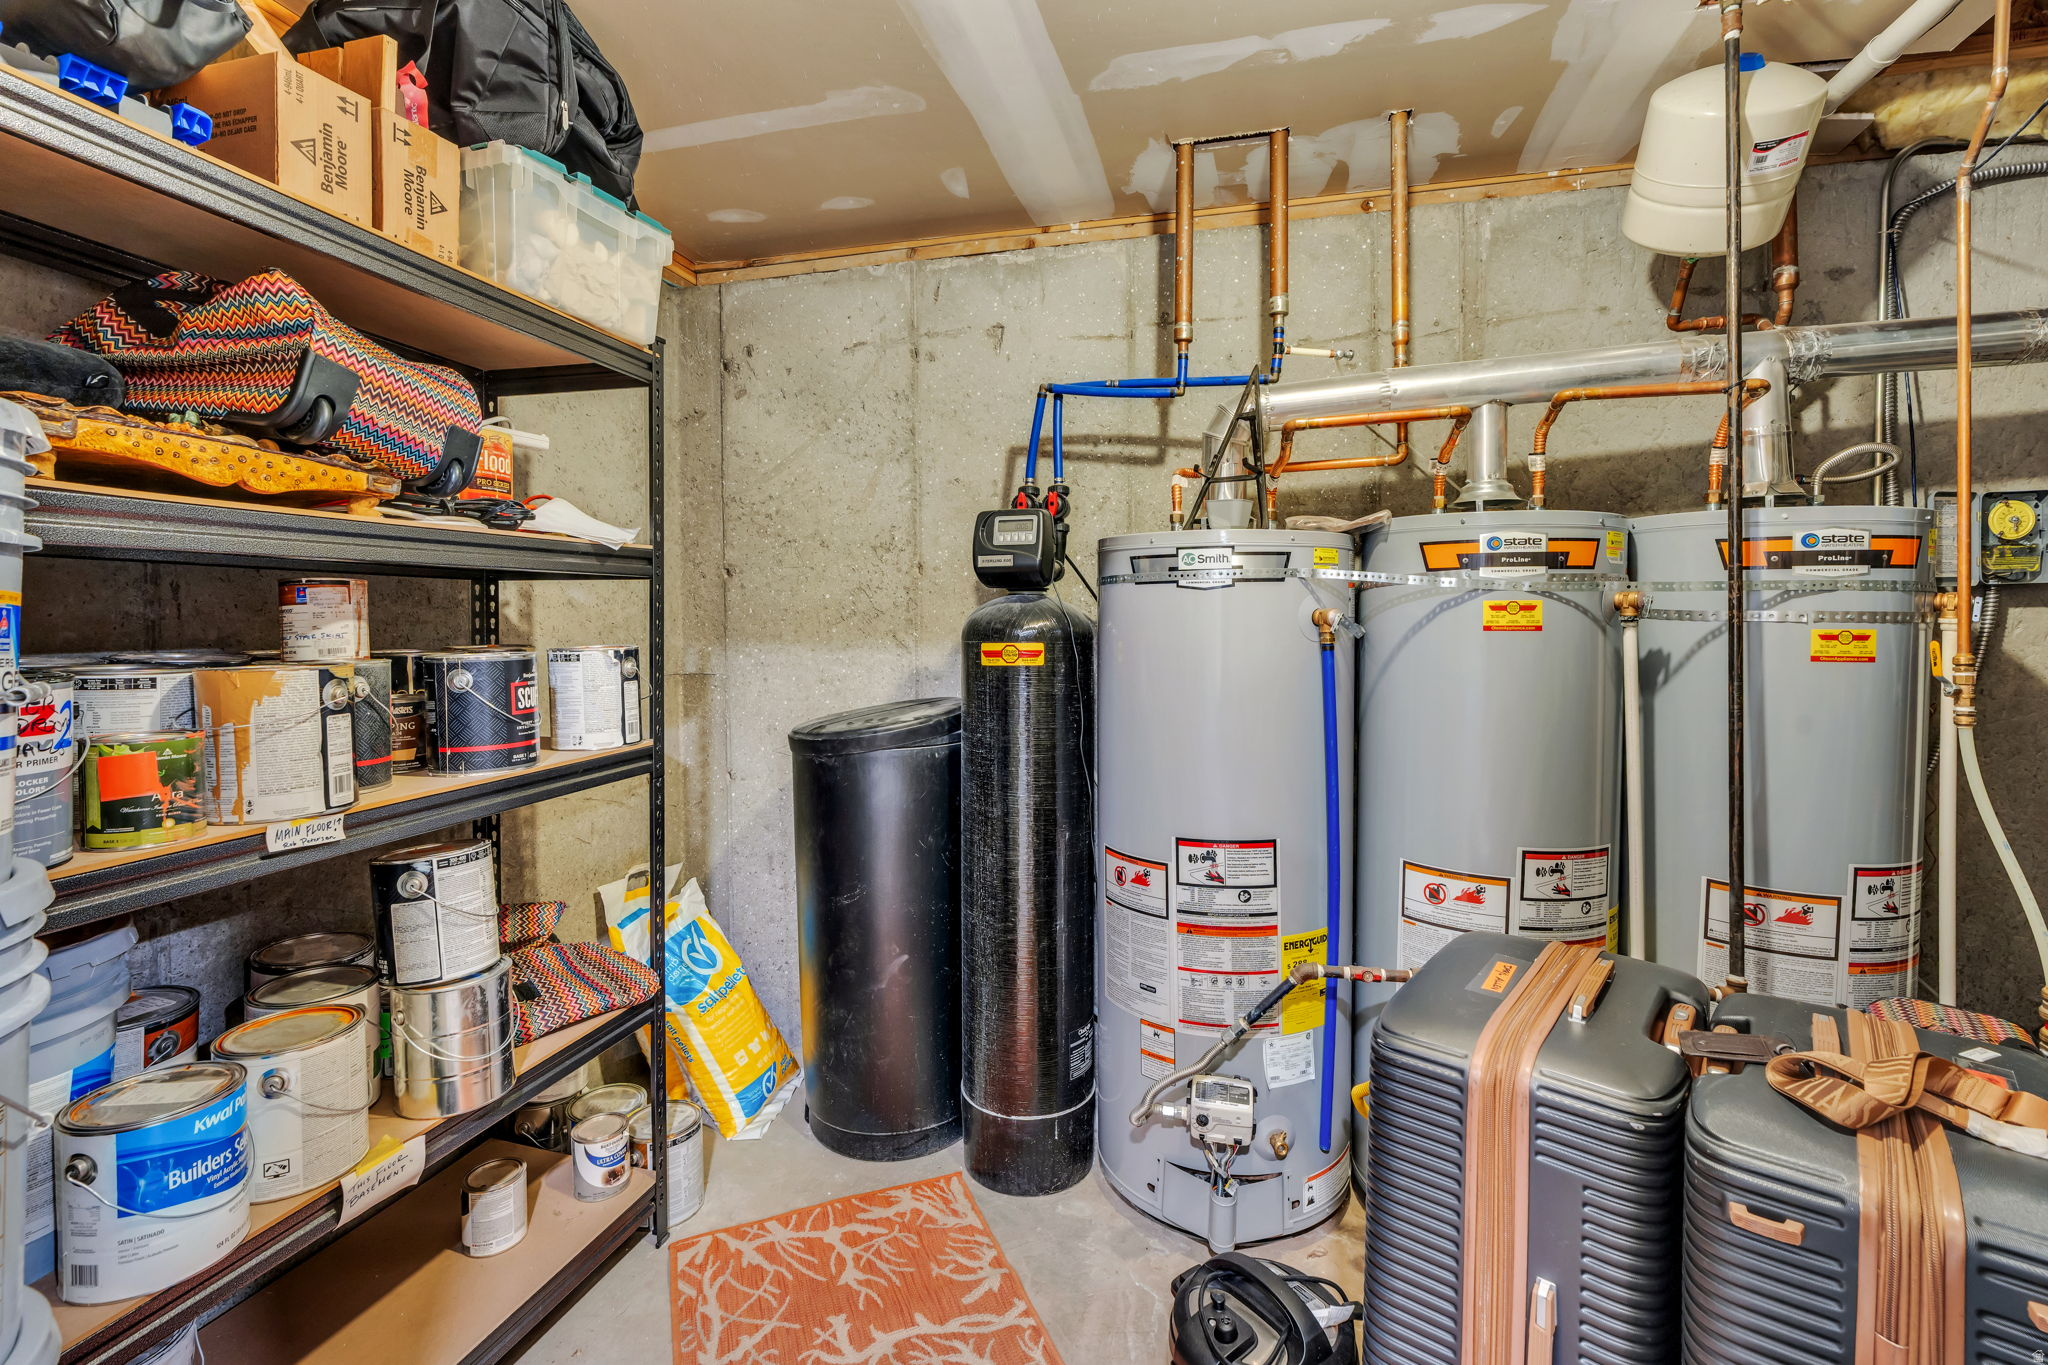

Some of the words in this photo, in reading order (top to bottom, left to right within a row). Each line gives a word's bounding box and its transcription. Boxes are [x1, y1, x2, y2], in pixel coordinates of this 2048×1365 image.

[319, 122, 334, 195] Benjamin
[335, 140, 348, 191] Moore
[403, 168, 413, 217] Moore
[415, 164, 428, 231] Benjamin
[476, 478, 492, 486] PRO
[1503, 536, 1543, 546] state
[1821, 534, 1865, 543] state
[1197, 554, 1229, 564] Smith
[26, 755, 58, 767] PRIMER
[151, 790, 184, 802] Ara
[275, 825, 301, 843] MAIN
[673, 1036, 695, 1063] pellets
[194, 1100, 234, 1135] Kwal
[168, 1148, 232, 1190] Builders
[596, 1156, 614, 1165] ULTRA
[348, 1175, 371, 1193] THIS
[117, 1237, 133, 1247] SATIN
[137, 1228, 165, 1243] SATINADO
